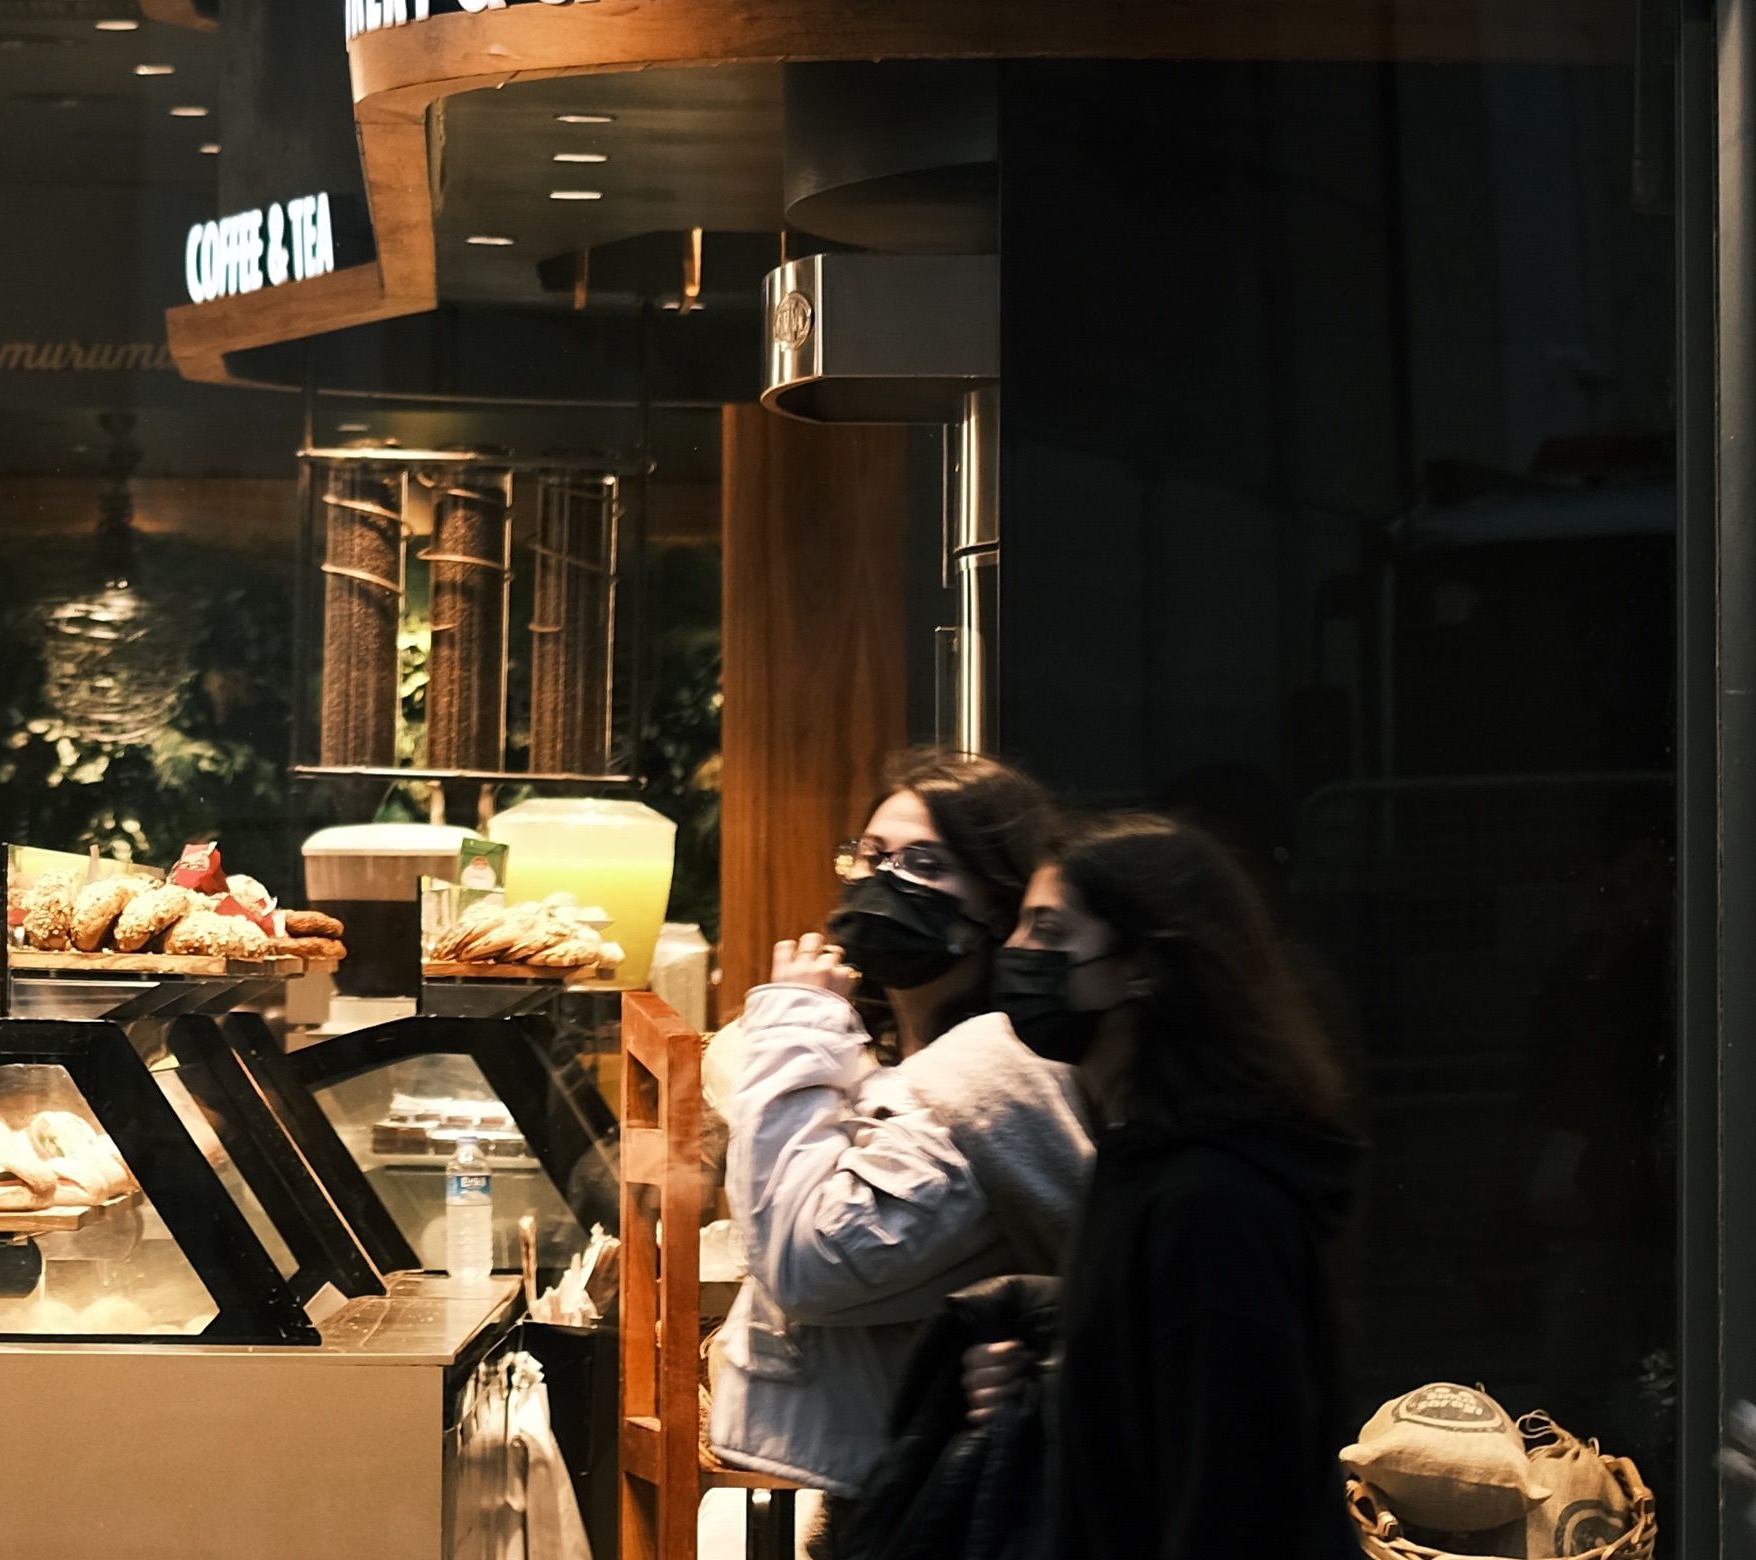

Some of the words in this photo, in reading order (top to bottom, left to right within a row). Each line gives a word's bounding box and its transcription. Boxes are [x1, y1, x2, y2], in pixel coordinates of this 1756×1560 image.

[186, 209, 264, 304] COFFEE
[267, 201, 290, 286] &
[287, 191, 335, 282] TEA
